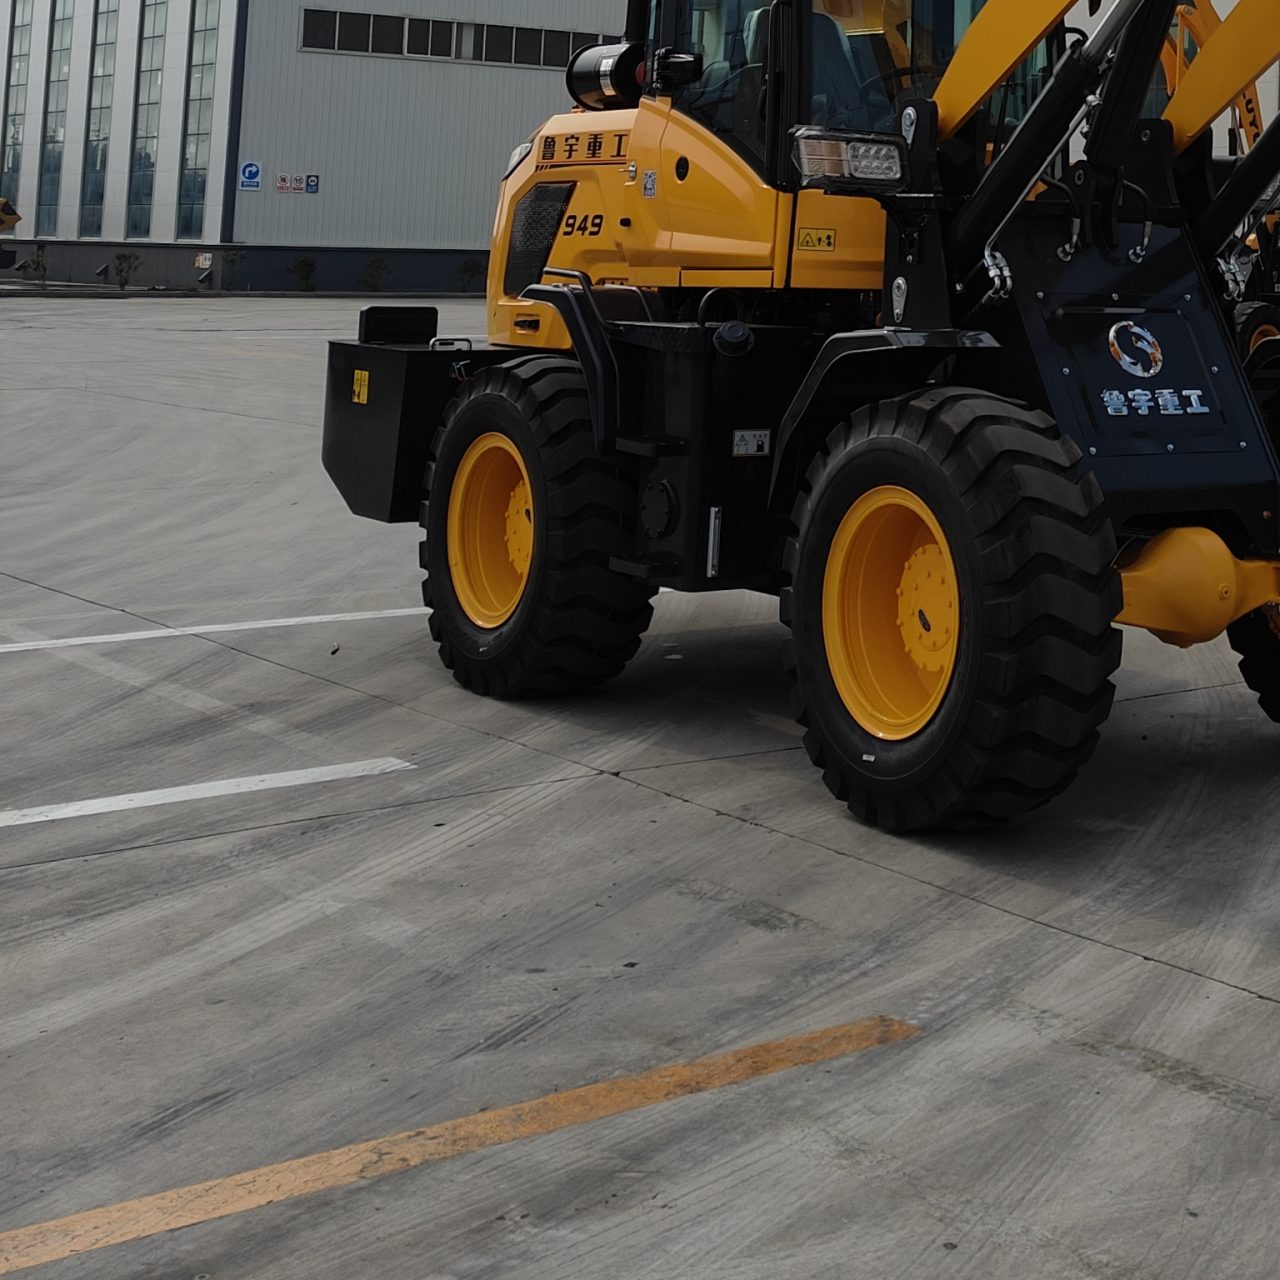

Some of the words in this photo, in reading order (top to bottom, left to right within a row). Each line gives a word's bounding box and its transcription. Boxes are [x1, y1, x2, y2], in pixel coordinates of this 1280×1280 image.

[541, 133, 629, 161] 鲁宇重工
[562, 214, 604, 236] 949
[1101, 388, 1211, 416] 鲁宇重工
